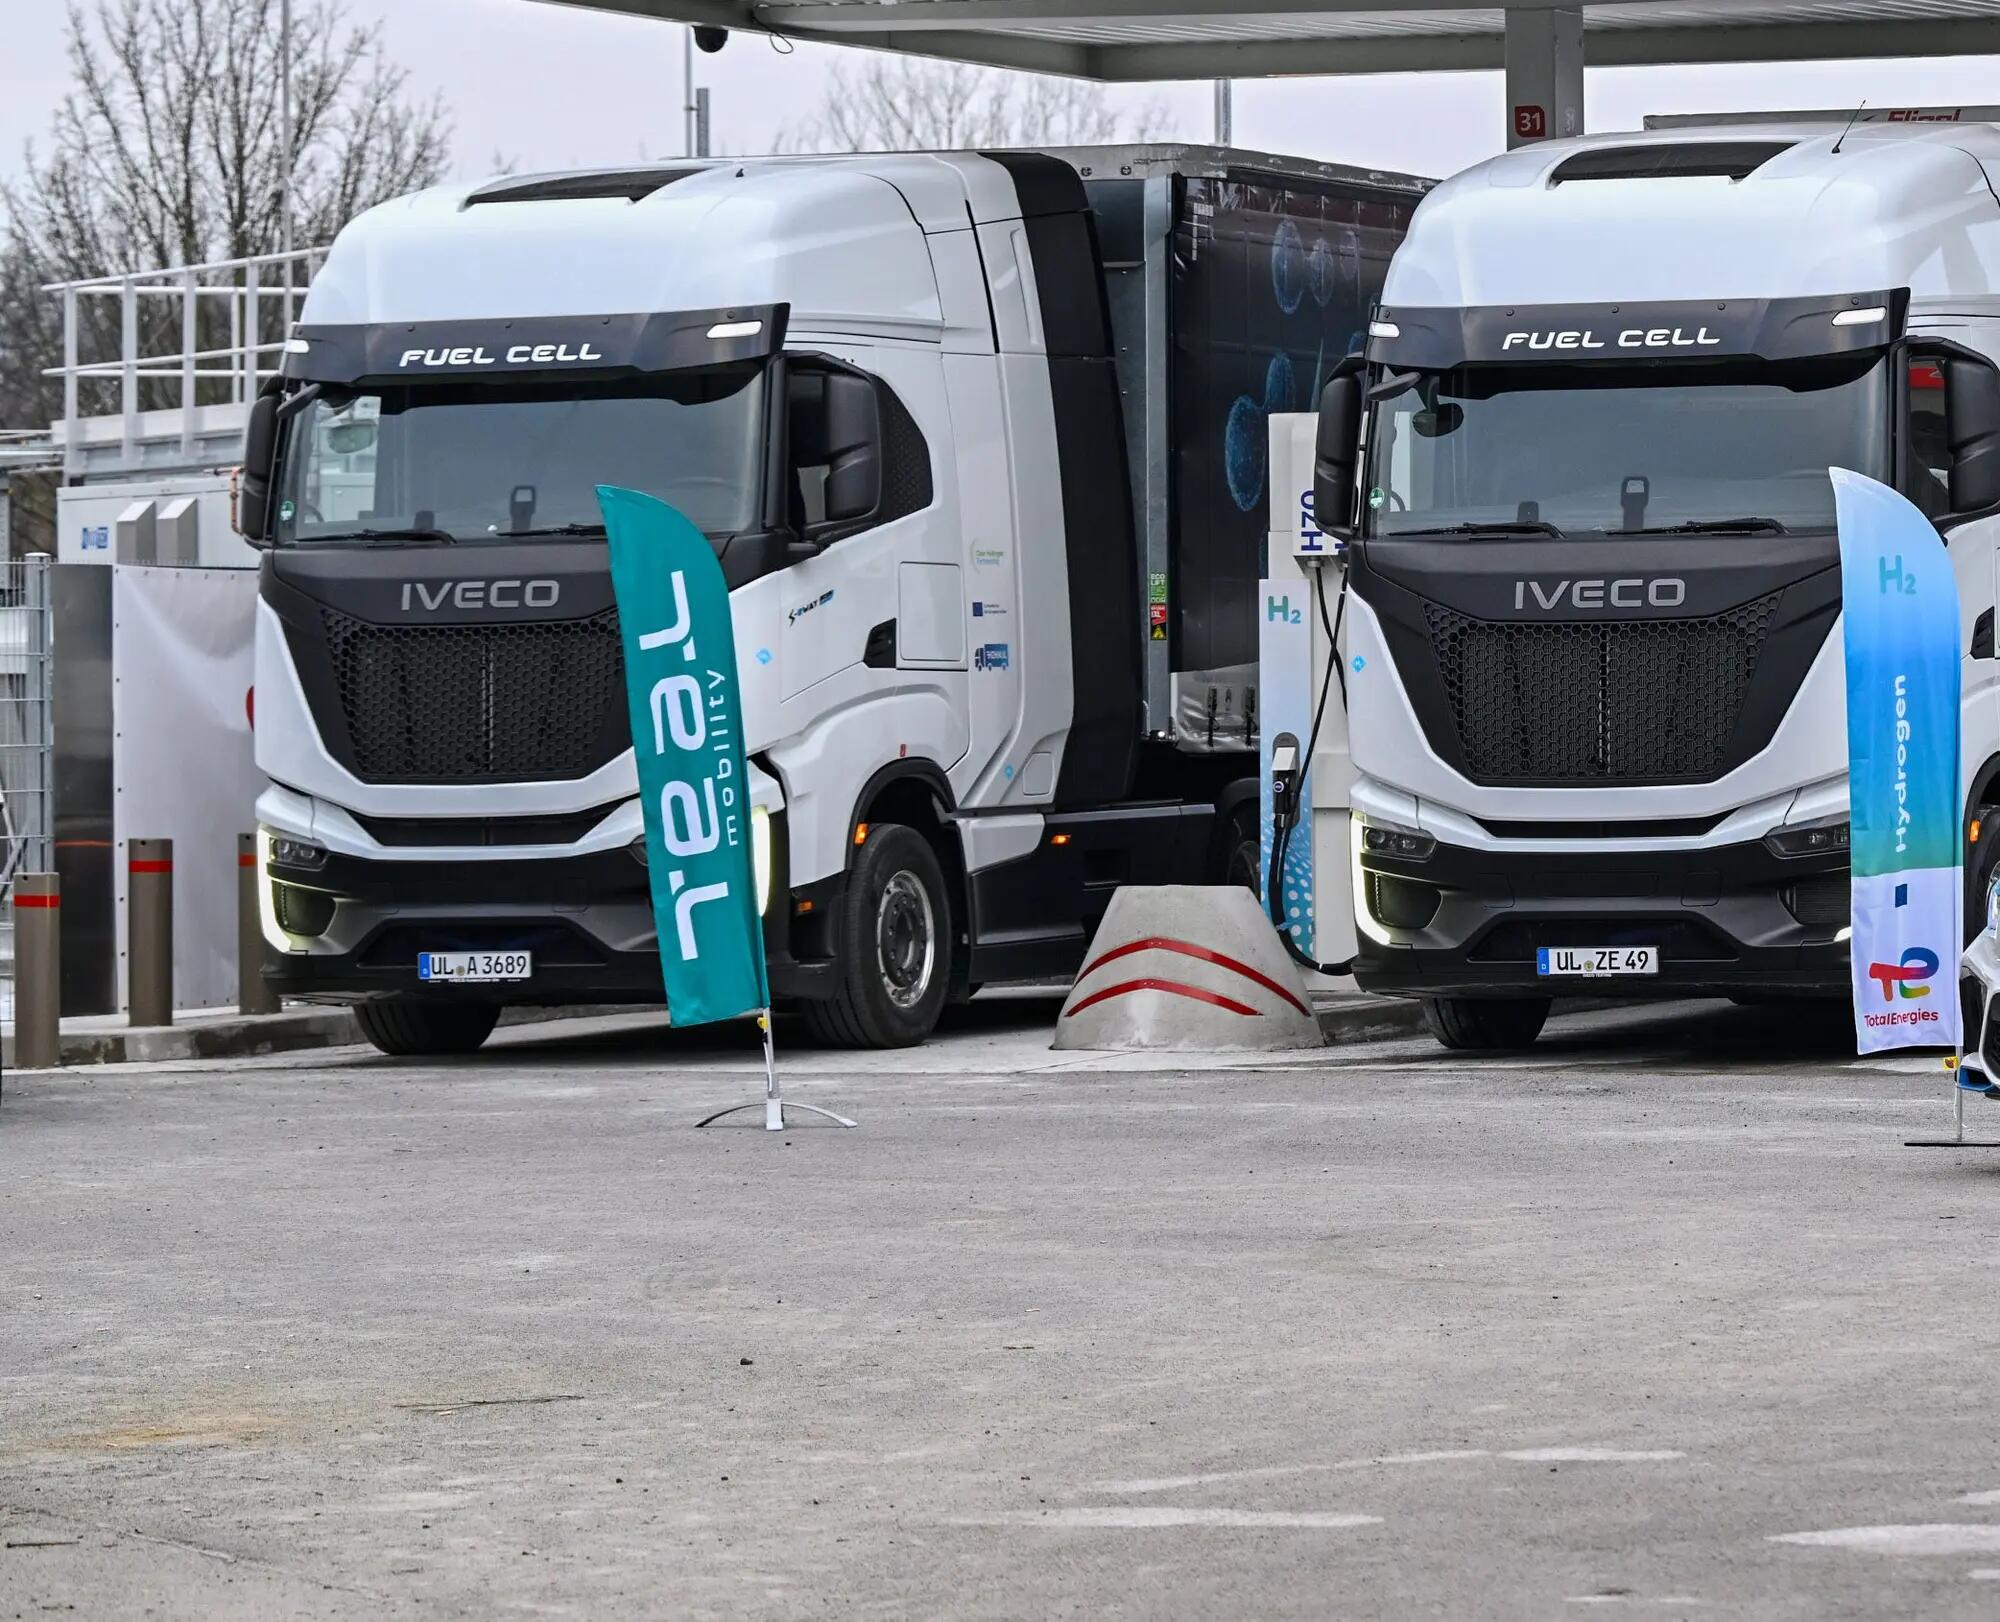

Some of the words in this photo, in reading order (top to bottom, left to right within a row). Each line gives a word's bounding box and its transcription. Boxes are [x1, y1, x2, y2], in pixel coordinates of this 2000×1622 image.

[1520, 111, 1541, 131] 31
[1502, 330, 1605, 350] FUEL
[1618, 327, 1721, 347] CELL
[399, 347, 495, 367] FUEL
[506, 343, 602, 363] CELL
[401, 580, 560, 611] IVECO
[1515, 578, 1686, 610] IVECO
[638, 570, 729, 961] real
[706, 669, 738, 846] mobility
[1894, 674, 1910, 853] Hydrogen
[432, 957, 454, 975] UL
[467, 957, 478, 974] A
[482, 955, 527, 974] 3689
[1557, 952, 1582, 970] UL
[1595, 951, 1620, 970] ZE
[1625, 950, 1649, 970] 49
[1864, 1008, 1939, 1027] TotalEnergies
